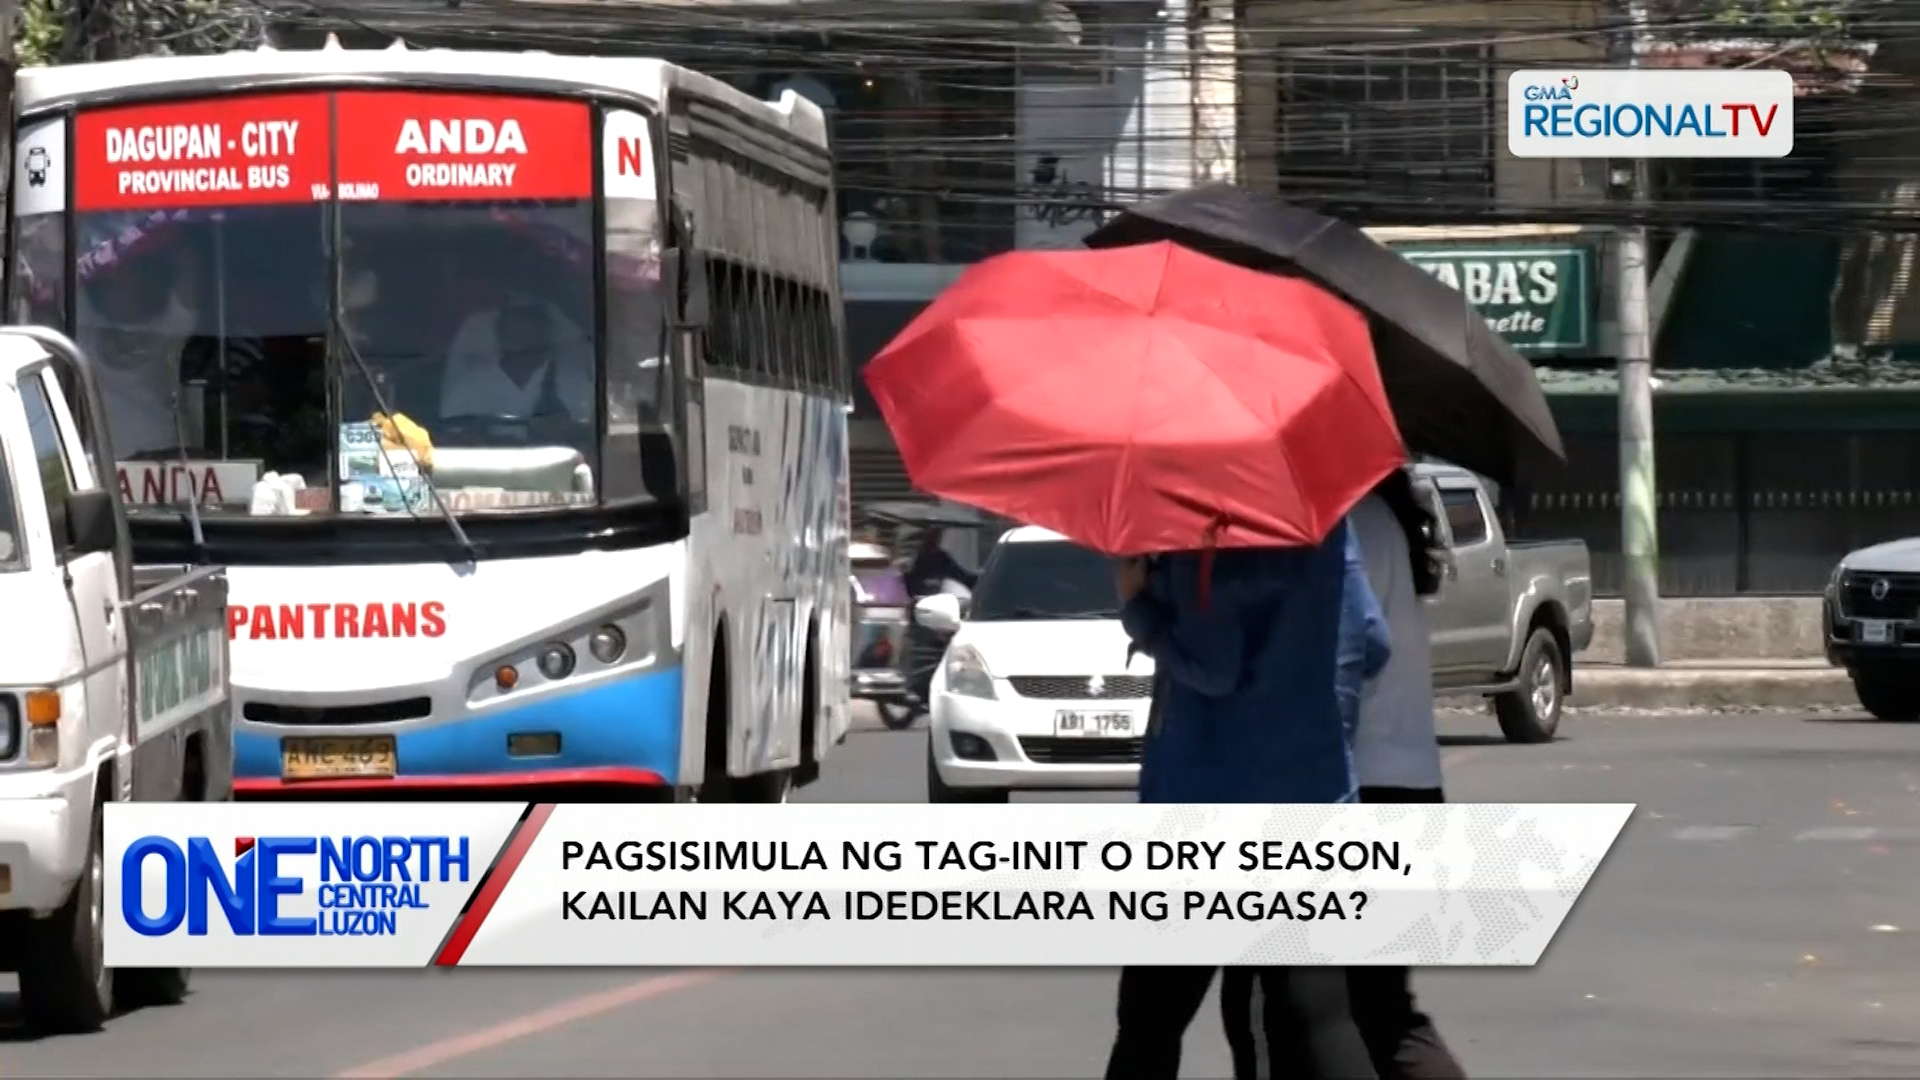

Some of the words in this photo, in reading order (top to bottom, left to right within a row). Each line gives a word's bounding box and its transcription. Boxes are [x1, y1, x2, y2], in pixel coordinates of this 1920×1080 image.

[106, 123, 221, 163] DAGUPAN
[241, 120, 298, 157] CITY
[395, 119, 527, 153] ANDA
[406, 163, 516, 186] ORDINARY
[618, 137, 641, 177] N
[118, 168, 242, 194] PROVINCIAL
[247, 165, 290, 188] BUS
[117, 466, 223, 503] ANDA
[229, 602, 446, 640] PANTRANS
